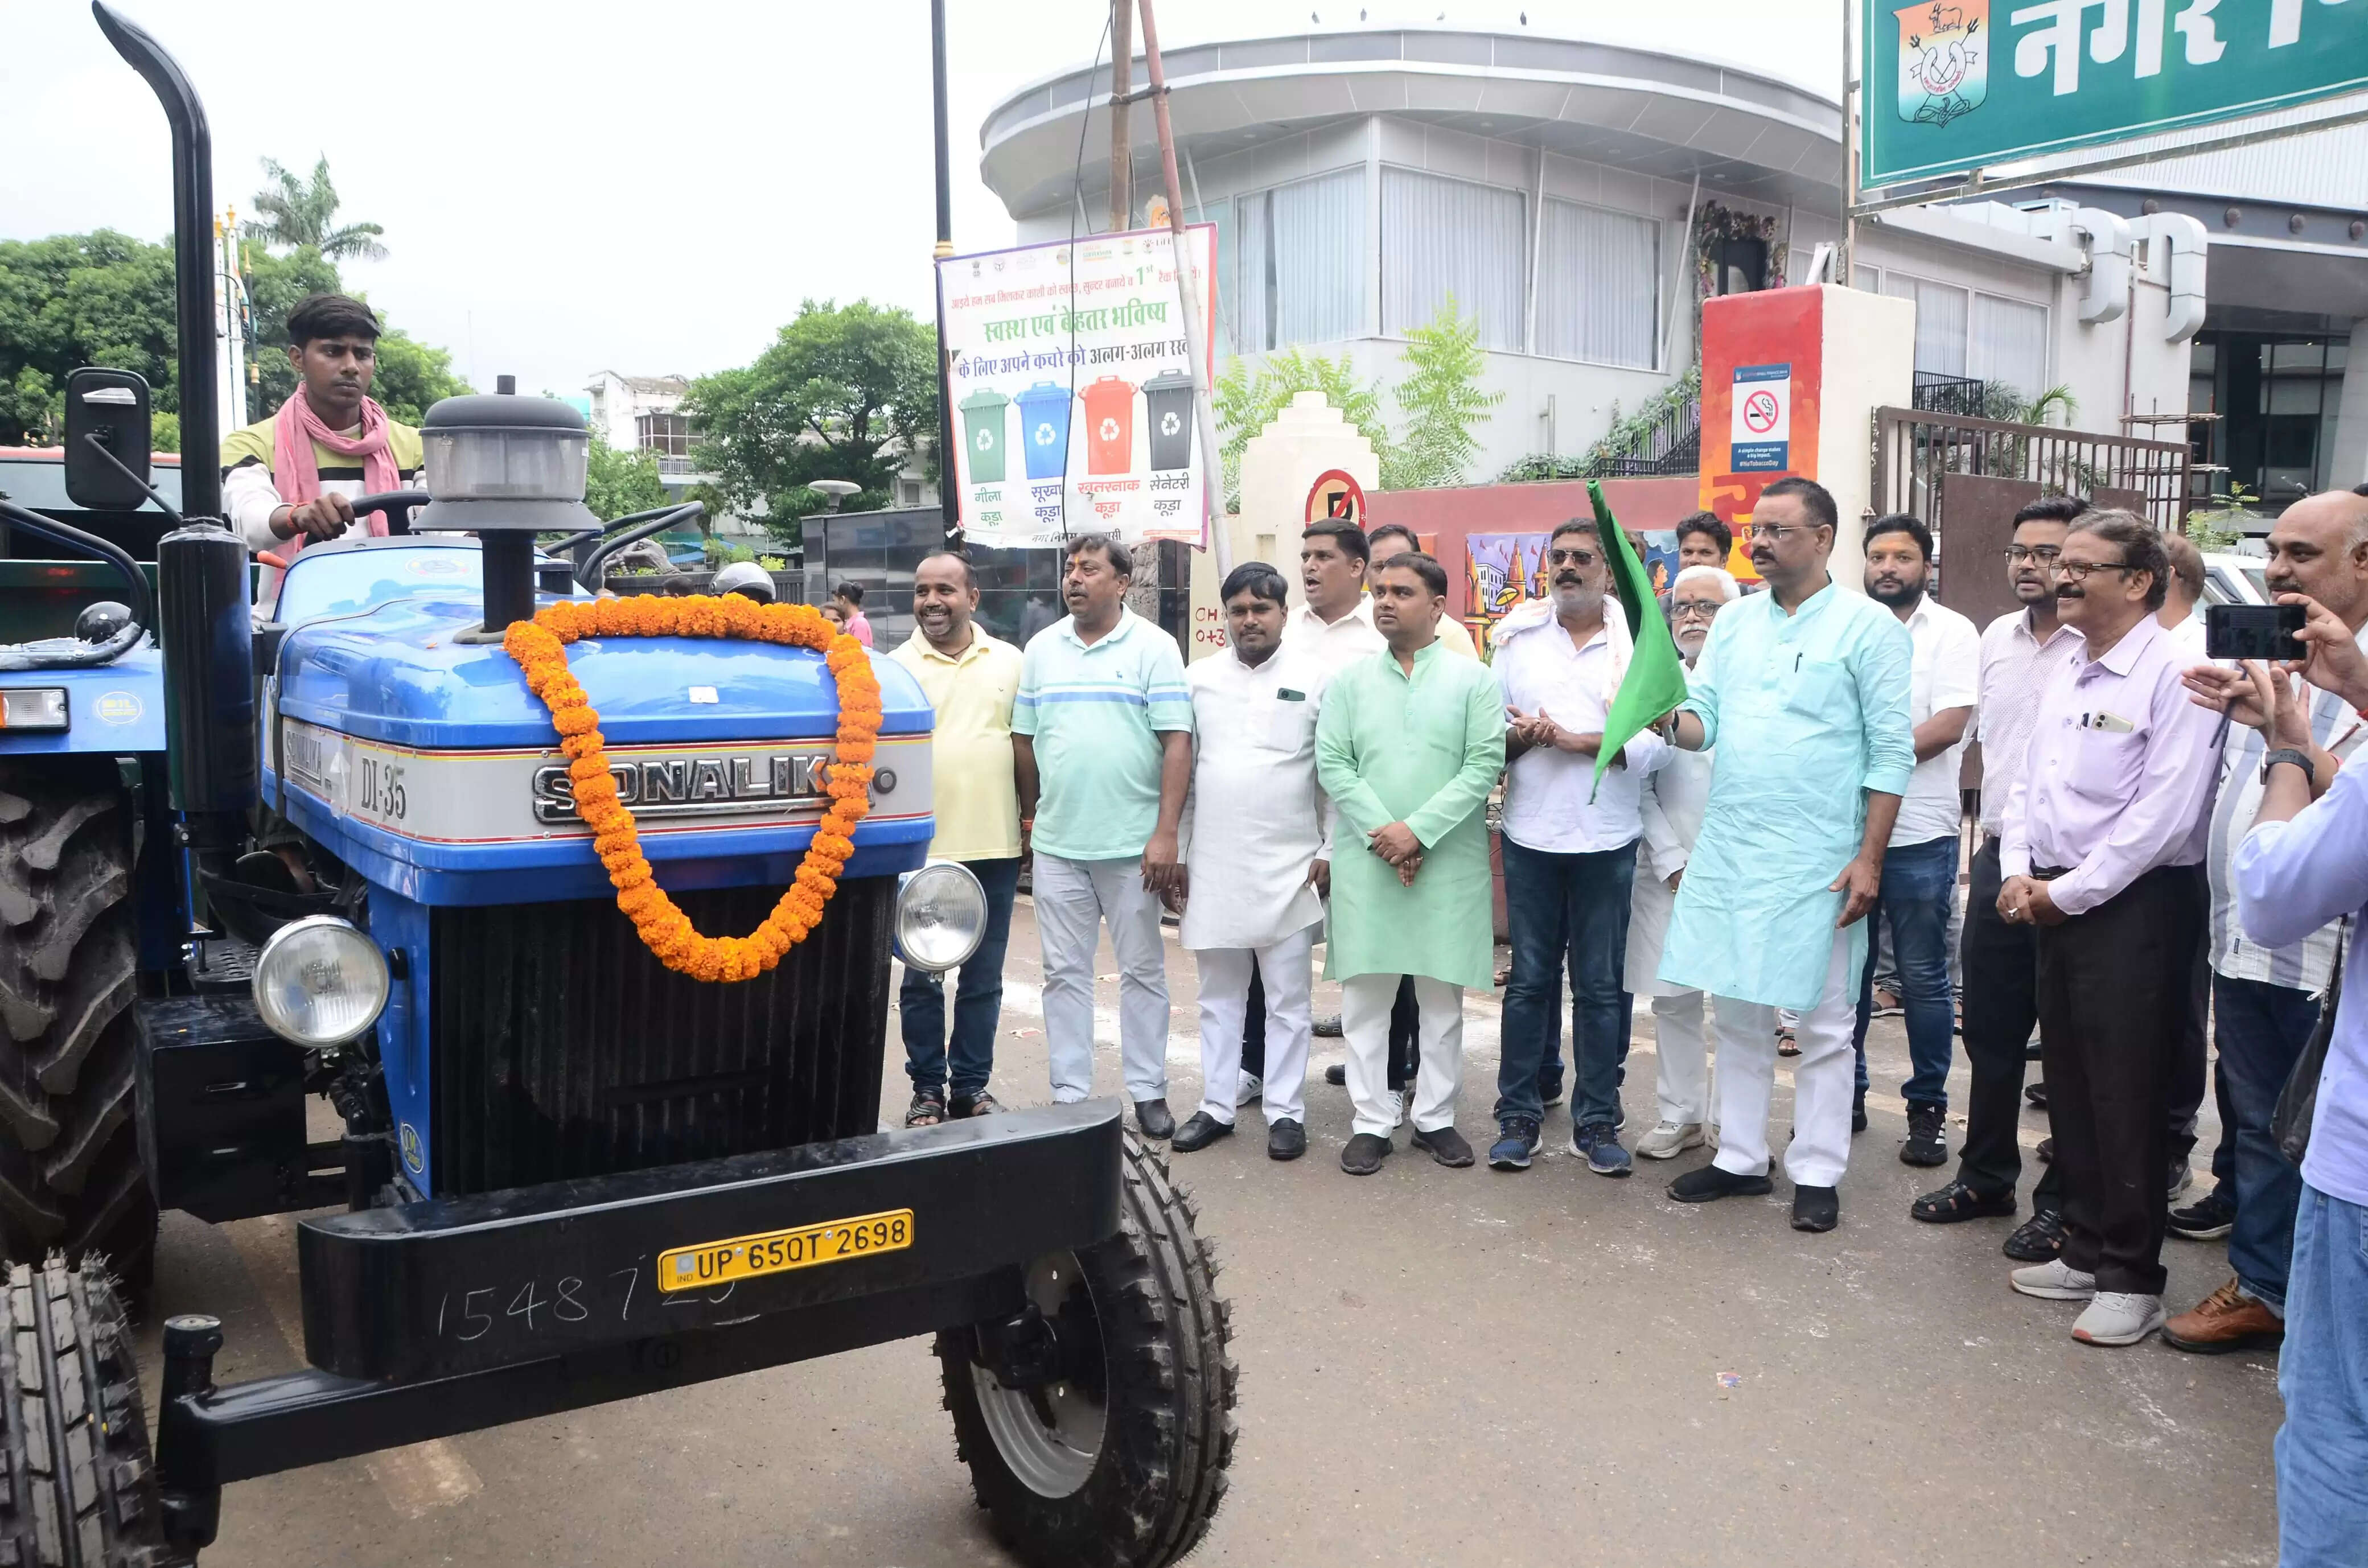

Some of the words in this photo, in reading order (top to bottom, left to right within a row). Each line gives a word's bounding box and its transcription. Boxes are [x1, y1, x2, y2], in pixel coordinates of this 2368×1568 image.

[1030, 304, 1057, 336] एवं
[1058, 306, 1108, 333] बेहतर
[1112, 298, 1168, 328] भविष्य
[959, 358, 970, 378] के
[973, 356, 997, 377] लिए
[1001, 350, 1031, 373] अपने
[1033, 346, 1065, 369] कचरे
[1067, 344, 1086, 365] को
[975, 487, 1002, 503] गीला
[361, 756, 408, 820] DI-35
[532, 755, 875, 825] SONALIK
[698, 1249, 733, 1278] UP
[837, 1219, 905, 1254] 2698
[676, 1274, 693, 1283] IND
